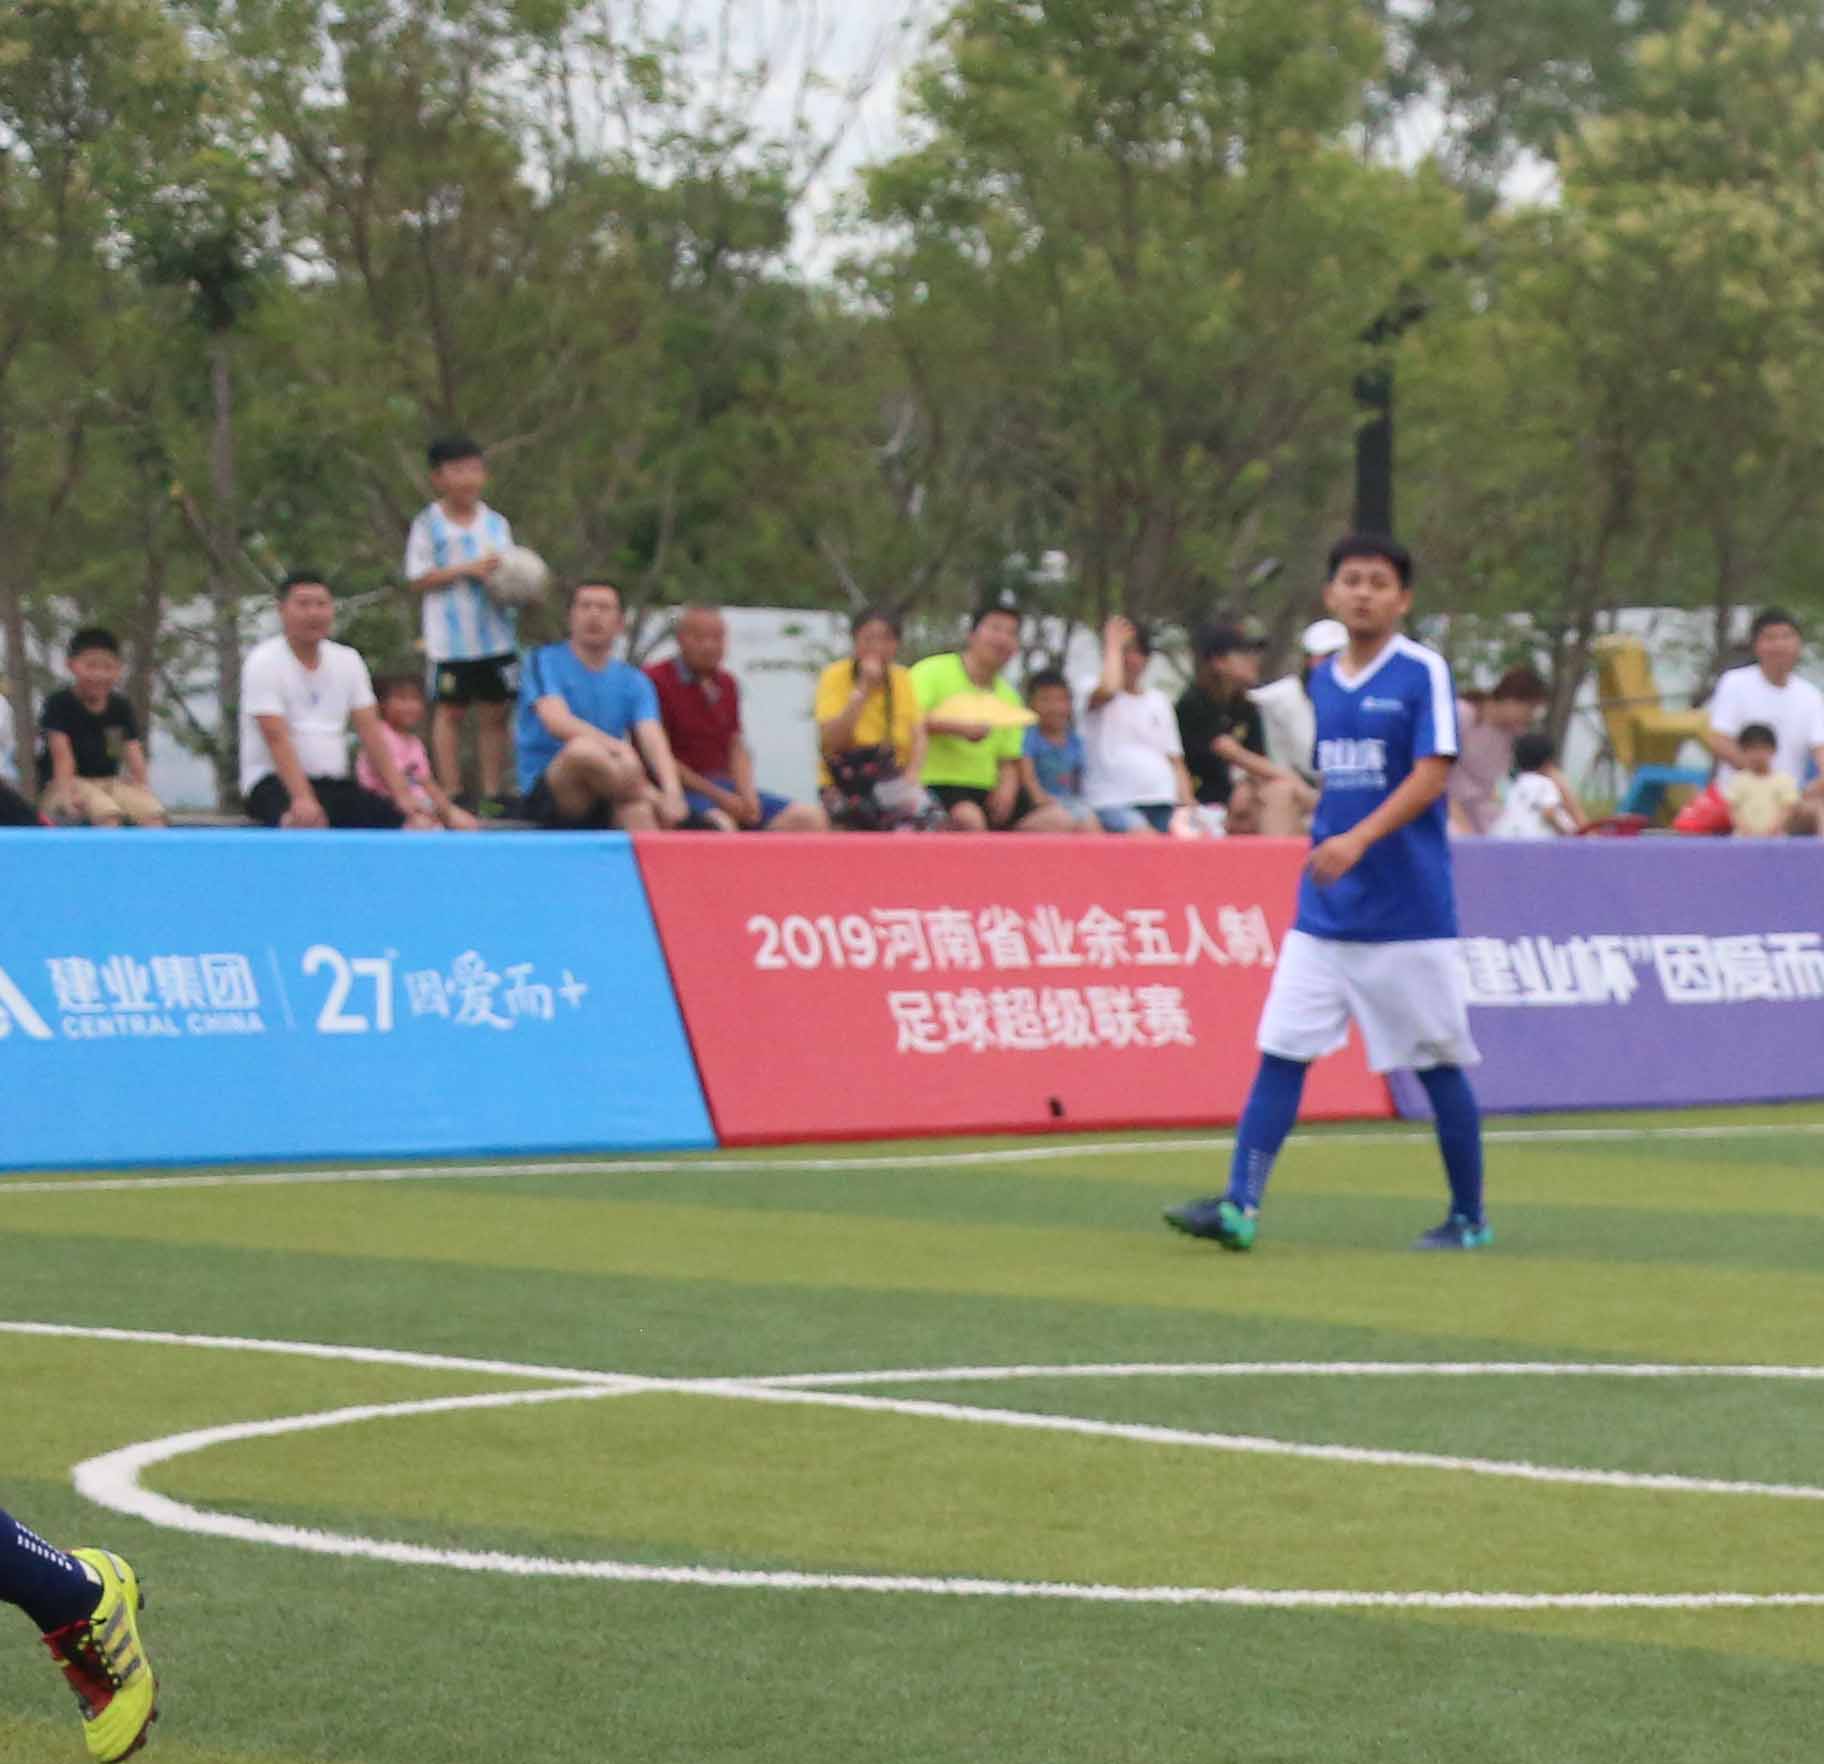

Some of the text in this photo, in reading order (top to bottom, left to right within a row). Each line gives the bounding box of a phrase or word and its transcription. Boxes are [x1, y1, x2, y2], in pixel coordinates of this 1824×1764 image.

[747, 904, 1277, 972] 2019河南省业余五人制
[45, 952, 260, 1014] 建业集团
[302, 943, 394, 1032] 27
[888, 983, 1195, 1053] 足球超级联赛
